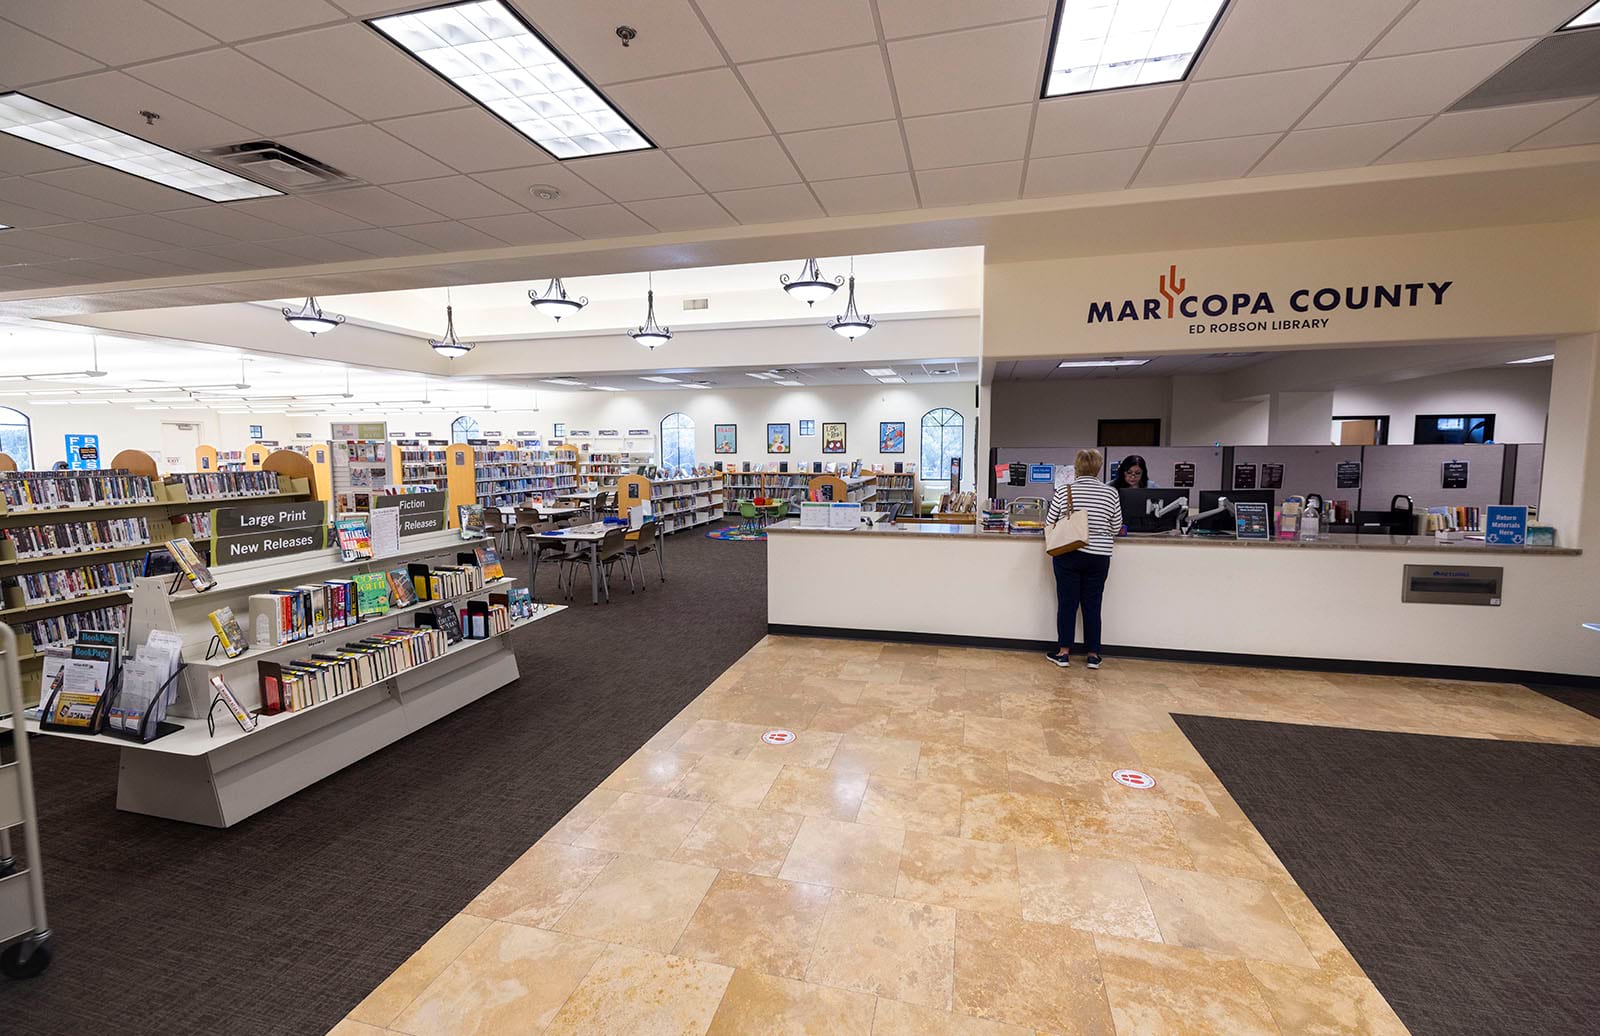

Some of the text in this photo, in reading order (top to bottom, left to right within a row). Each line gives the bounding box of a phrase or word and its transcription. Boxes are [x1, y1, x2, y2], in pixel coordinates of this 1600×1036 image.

[1290, 281, 1453, 312] COUNTY
[1189, 318, 1330, 335] ED ROBSON LIBRARY
[399, 499, 426, 510] Fiction
[240, 509, 307, 529] Large Print
[404, 518, 438, 531] Releases
[1491, 521, 1521, 529] Materials
[230, 534, 314, 556] New Releases
[81, 632, 116, 645] BookPage
[75, 646, 109, 659] BookPage
